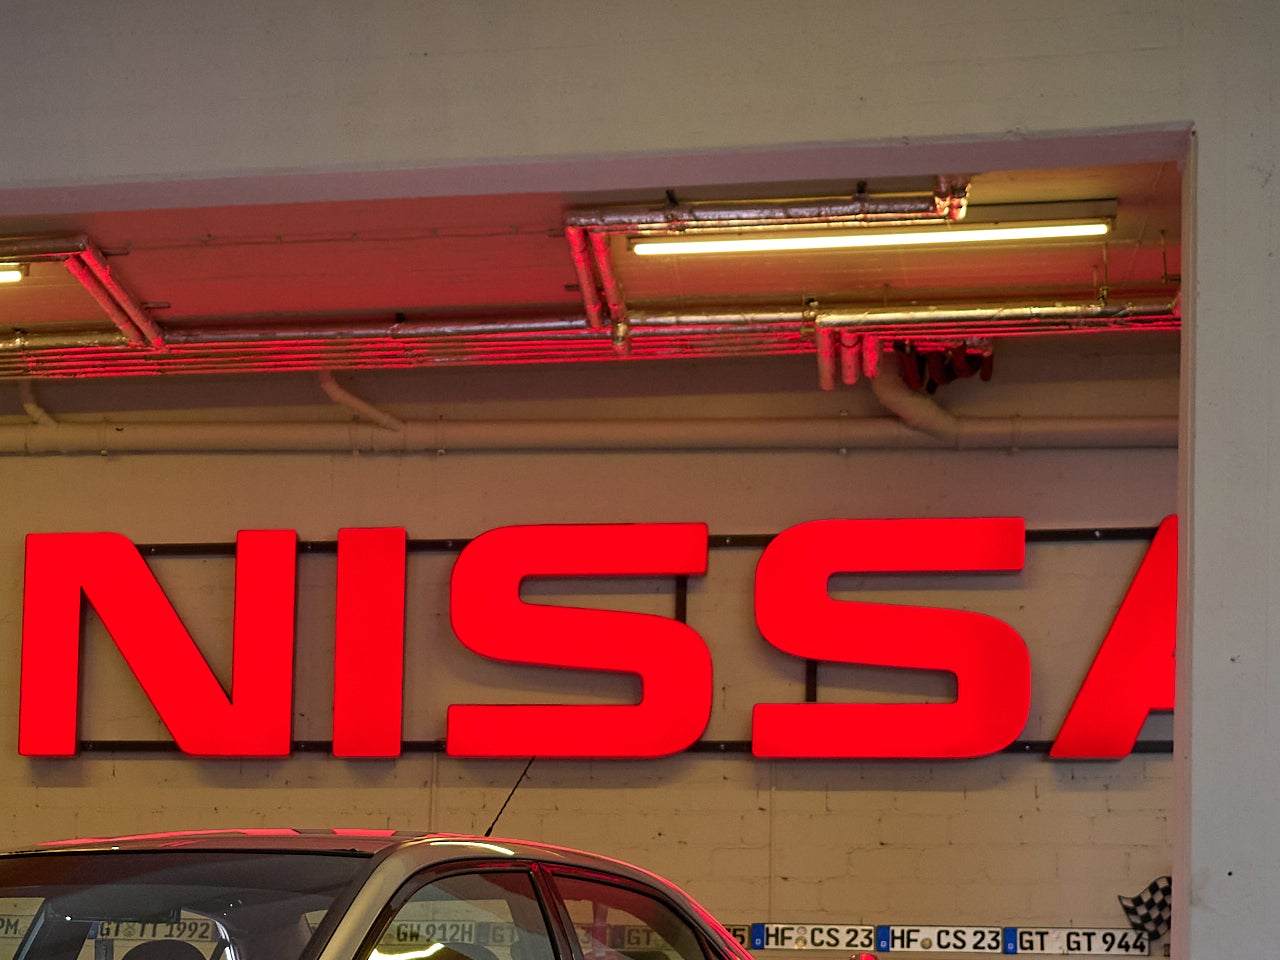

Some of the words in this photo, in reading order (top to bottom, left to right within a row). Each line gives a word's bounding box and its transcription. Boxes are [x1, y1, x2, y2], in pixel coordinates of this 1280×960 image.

[164, 921, 210, 939] 1992
[396, 923, 421, 942] GW
[425, 923, 473, 942] 912H
[765, 927, 794, 946] HF
[810, 927, 839, 947] CS
[846, 928, 873, 947] 23
[891, 929, 920, 948] HF
[937, 930, 966, 949] CS
[973, 930, 1000, 950] 23
[1019, 931, 1049, 951] GT
[1066, 932, 1095, 952] GT
[1102, 932, 1146, 953] 944
